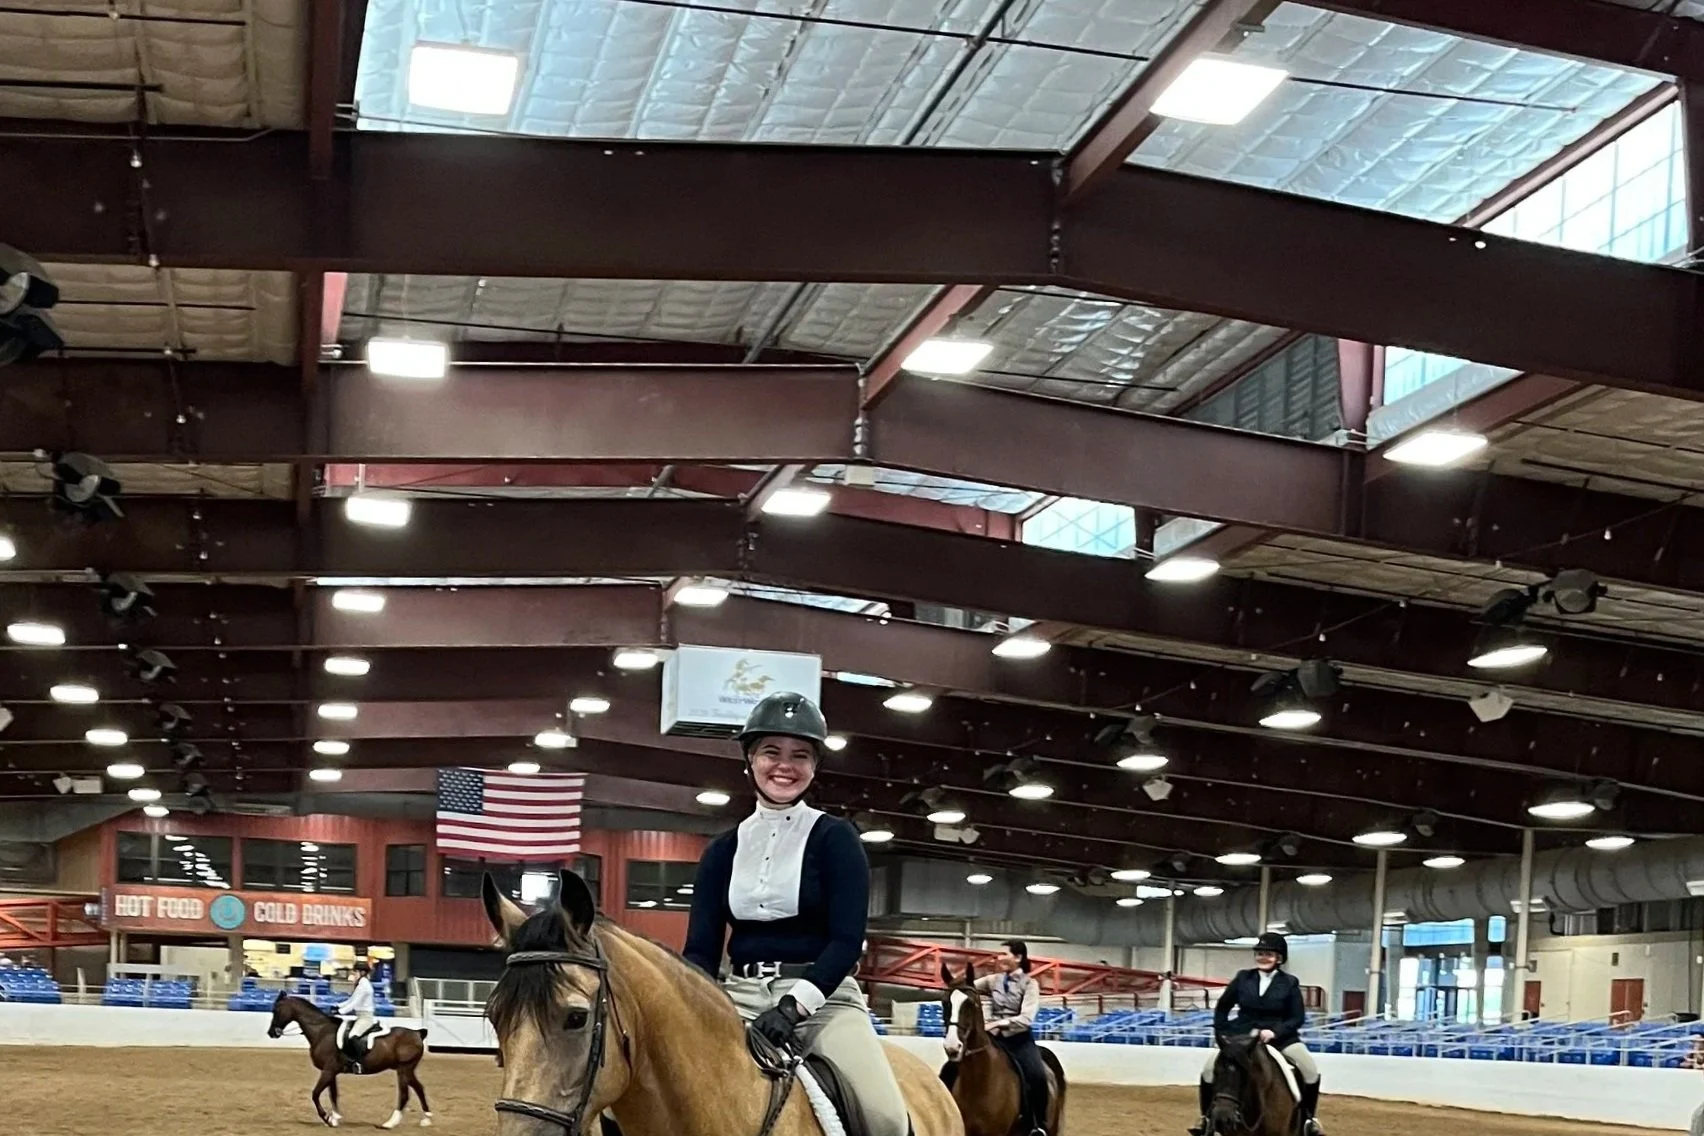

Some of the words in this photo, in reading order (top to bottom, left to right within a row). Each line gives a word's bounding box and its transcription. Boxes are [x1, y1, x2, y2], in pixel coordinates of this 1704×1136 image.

[114, 894, 154, 918] HOT
[156, 896, 205, 920] FOOD
[254, 900, 298, 925] COLD
[301, 902, 368, 928] DRINKS
